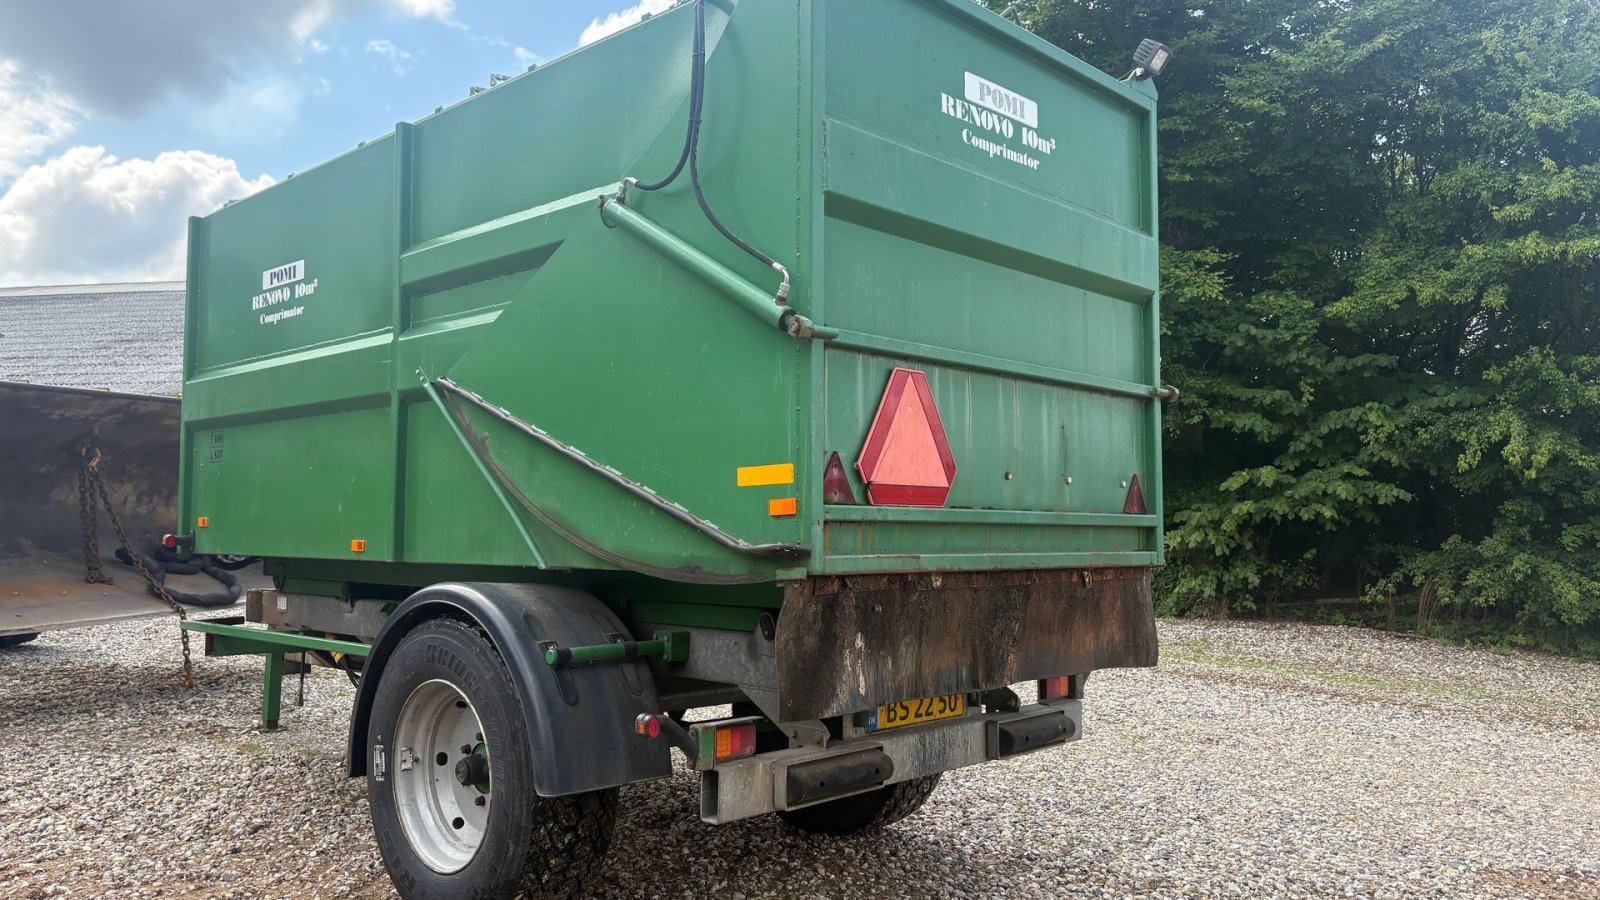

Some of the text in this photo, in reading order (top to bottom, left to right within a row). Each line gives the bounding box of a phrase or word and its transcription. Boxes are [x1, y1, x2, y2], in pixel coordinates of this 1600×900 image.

[940, 91, 1014, 139] RENOVO
[978, 81, 1025, 120] POMI
[962, 128, 1040, 170] Comprimator
[269, 265, 297, 286] POMI
[252, 286, 291, 311] RENOVO
[260, 305, 305, 325] Comprimator
